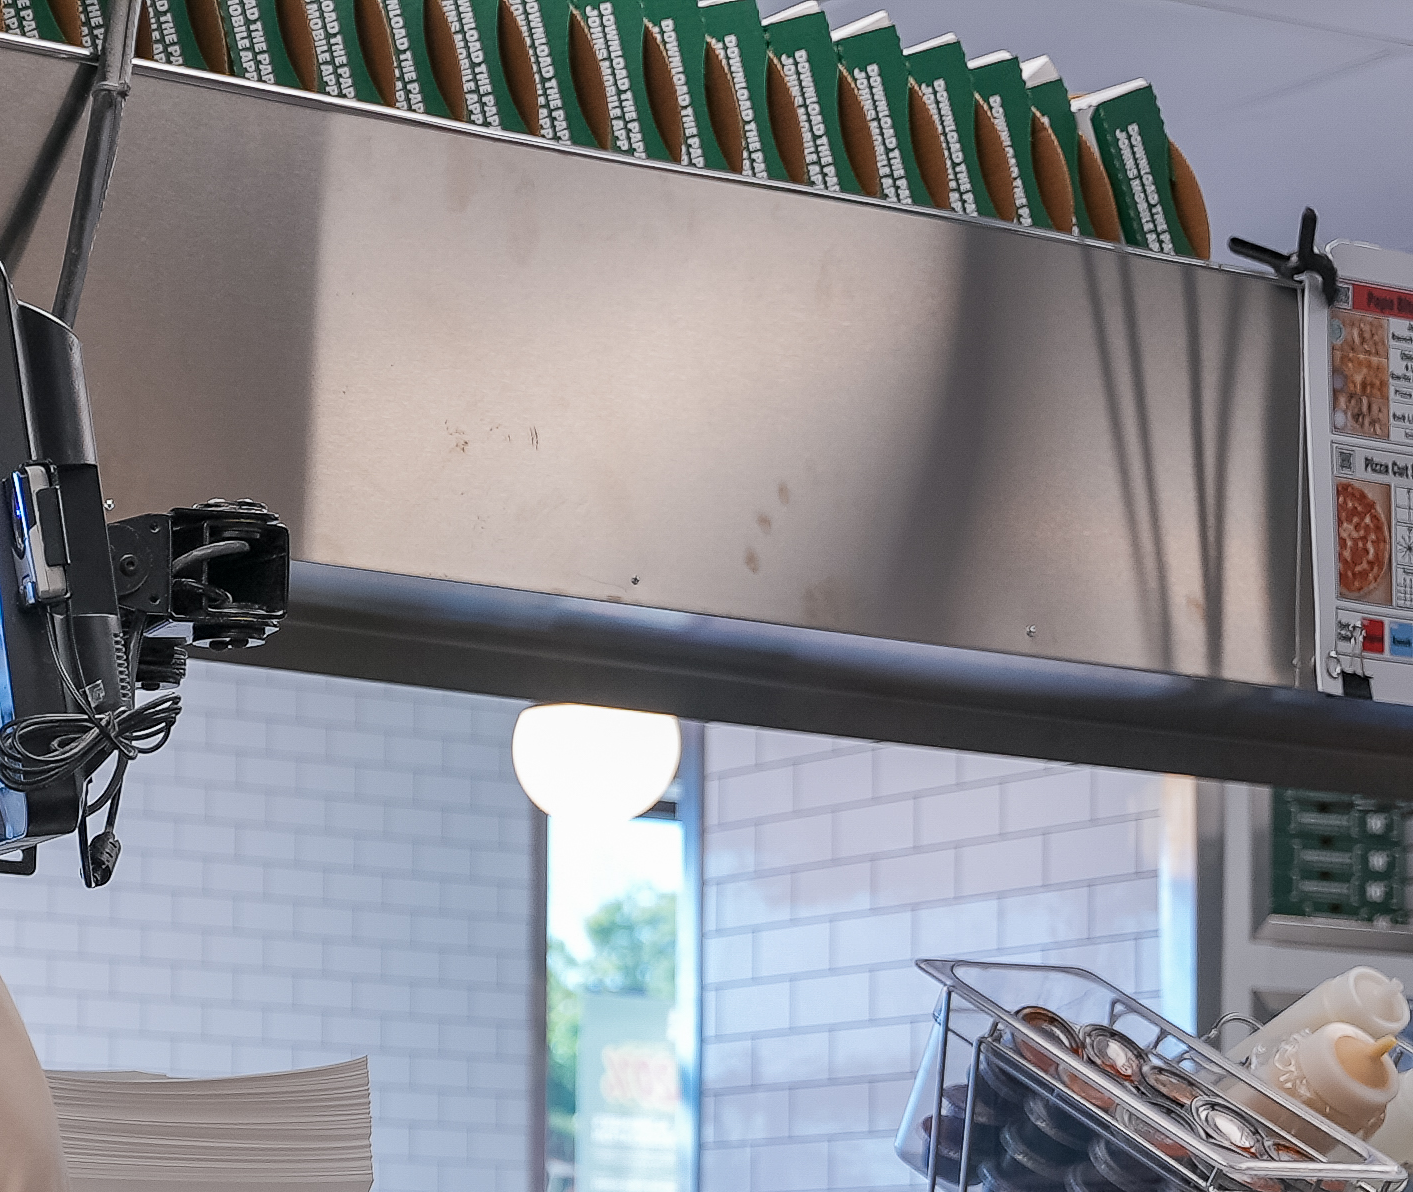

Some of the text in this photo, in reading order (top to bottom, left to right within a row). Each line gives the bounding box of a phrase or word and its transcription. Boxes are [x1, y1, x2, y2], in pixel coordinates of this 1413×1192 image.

[160, 14, 177, 44] THE
[250, 22, 266, 52] THE
[330, 35, 346, 66] THE
[400, 51, 416, 81] THE
[600, 2, 629, 90] DOWNLOAD
[621, 90, 637, 121] THE
[475, 64, 491, 94] THE
[545, 79, 562, 109] THE
[659, 19, 690, 106] DOWNLOAD
[681, 107, 697, 136] THE
[725, 35, 753, 121] DOWNLOAD
[745, 122, 760, 151] THE
[465, 94, 483, 127] APP
[795, 50, 824, 135] DOWNLOAD
[816, 136, 832, 165] THE
[867, 64, 896, 148] DOWNLOAD
[889, 149, 904, 178] THE
[612, 120, 628, 150] APP
[934, 79, 963, 163] DOWNLOAD
[955, 164, 970, 192] THE
[1128, 124, 1158, 204] DOWNLOAD
